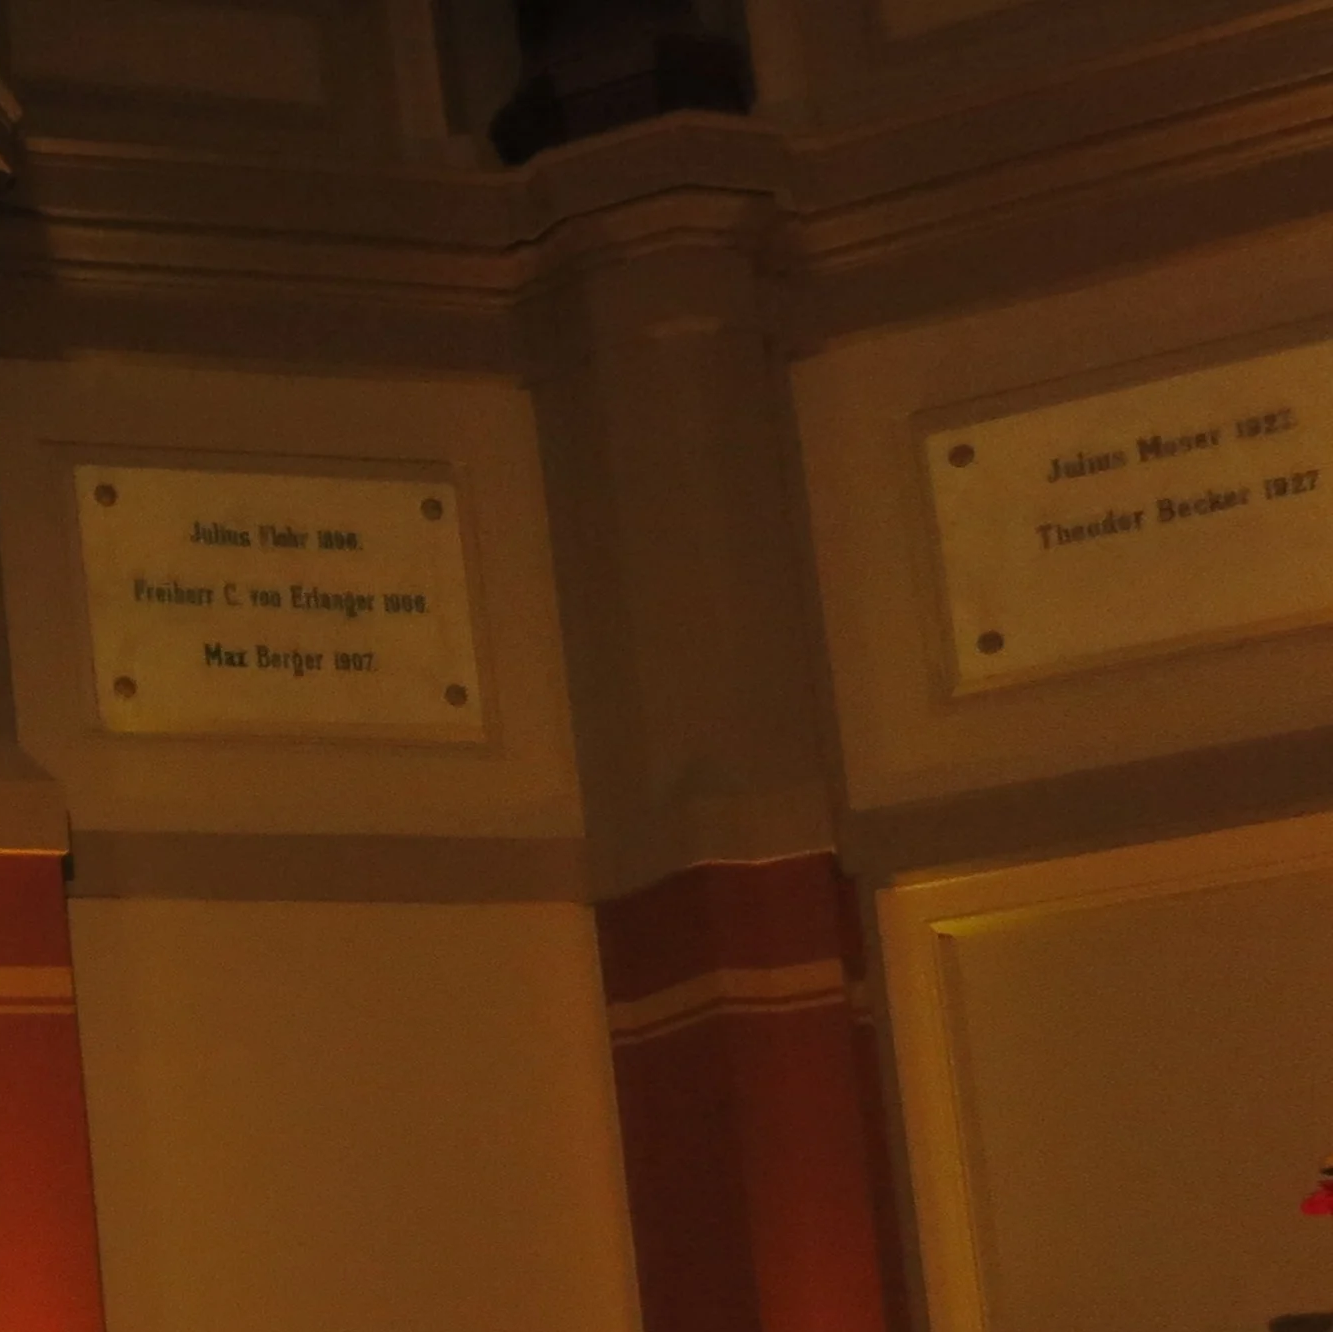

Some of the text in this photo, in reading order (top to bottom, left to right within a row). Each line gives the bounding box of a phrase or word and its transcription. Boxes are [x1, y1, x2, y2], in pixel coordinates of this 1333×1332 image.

[1048, 451, 1127, 483] Julius
[190, 521, 251, 547] Julius
[1036, 510, 1145, 550] Theodor
[1156, 487, 1251, 523] Becker
[134, 577, 214, 607] Freiherr
[251, 589, 282, 608] von
[290, 584, 375, 618] Erlanger
[204, 642, 247, 668] Max
[256, 644, 324, 677] Berger
